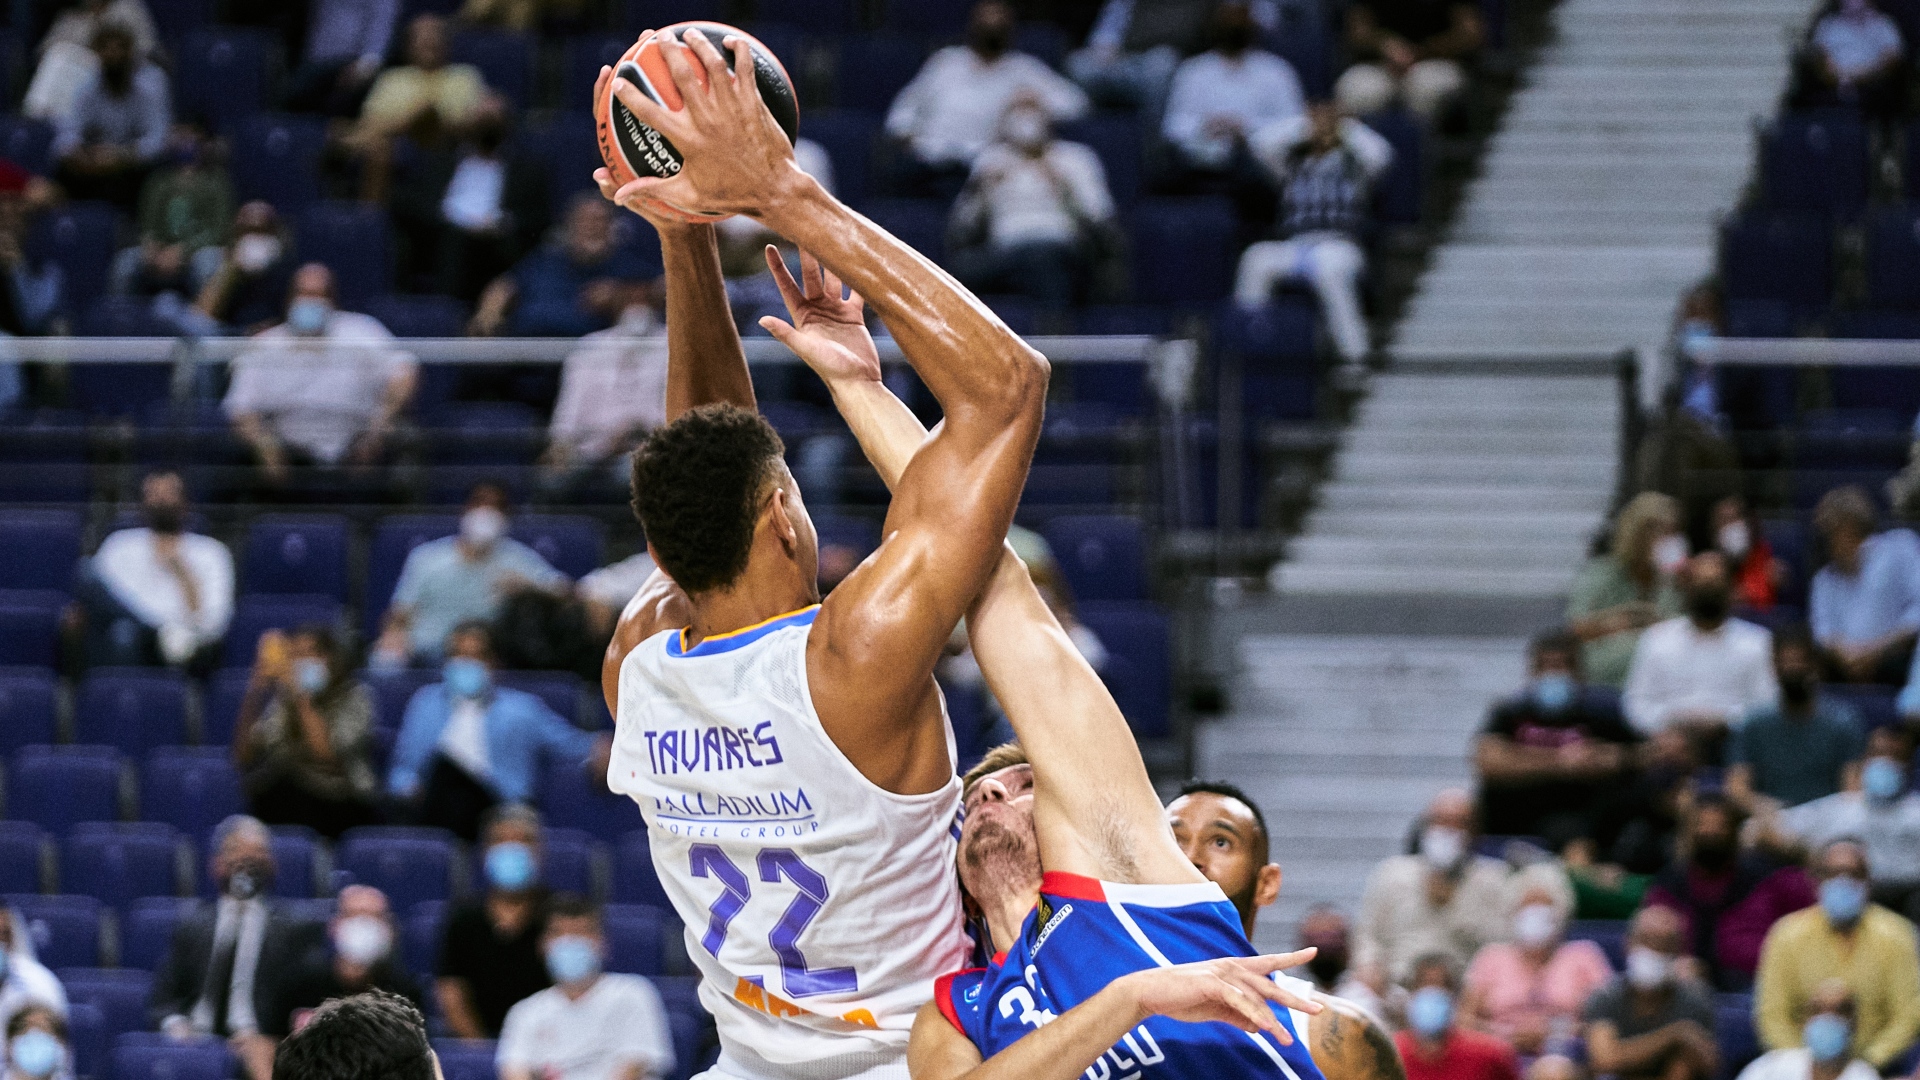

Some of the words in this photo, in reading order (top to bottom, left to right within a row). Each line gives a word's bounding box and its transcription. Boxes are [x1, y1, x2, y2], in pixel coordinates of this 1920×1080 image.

[621, 104, 648, 152] AIRLINE
[638, 120, 681, 172] oLeagu
[644, 151, 670, 178] KISH
[644, 720, 784, 774] TAVARES
[740, 821, 819, 838] GROUP
[688, 842, 858, 999] 22
